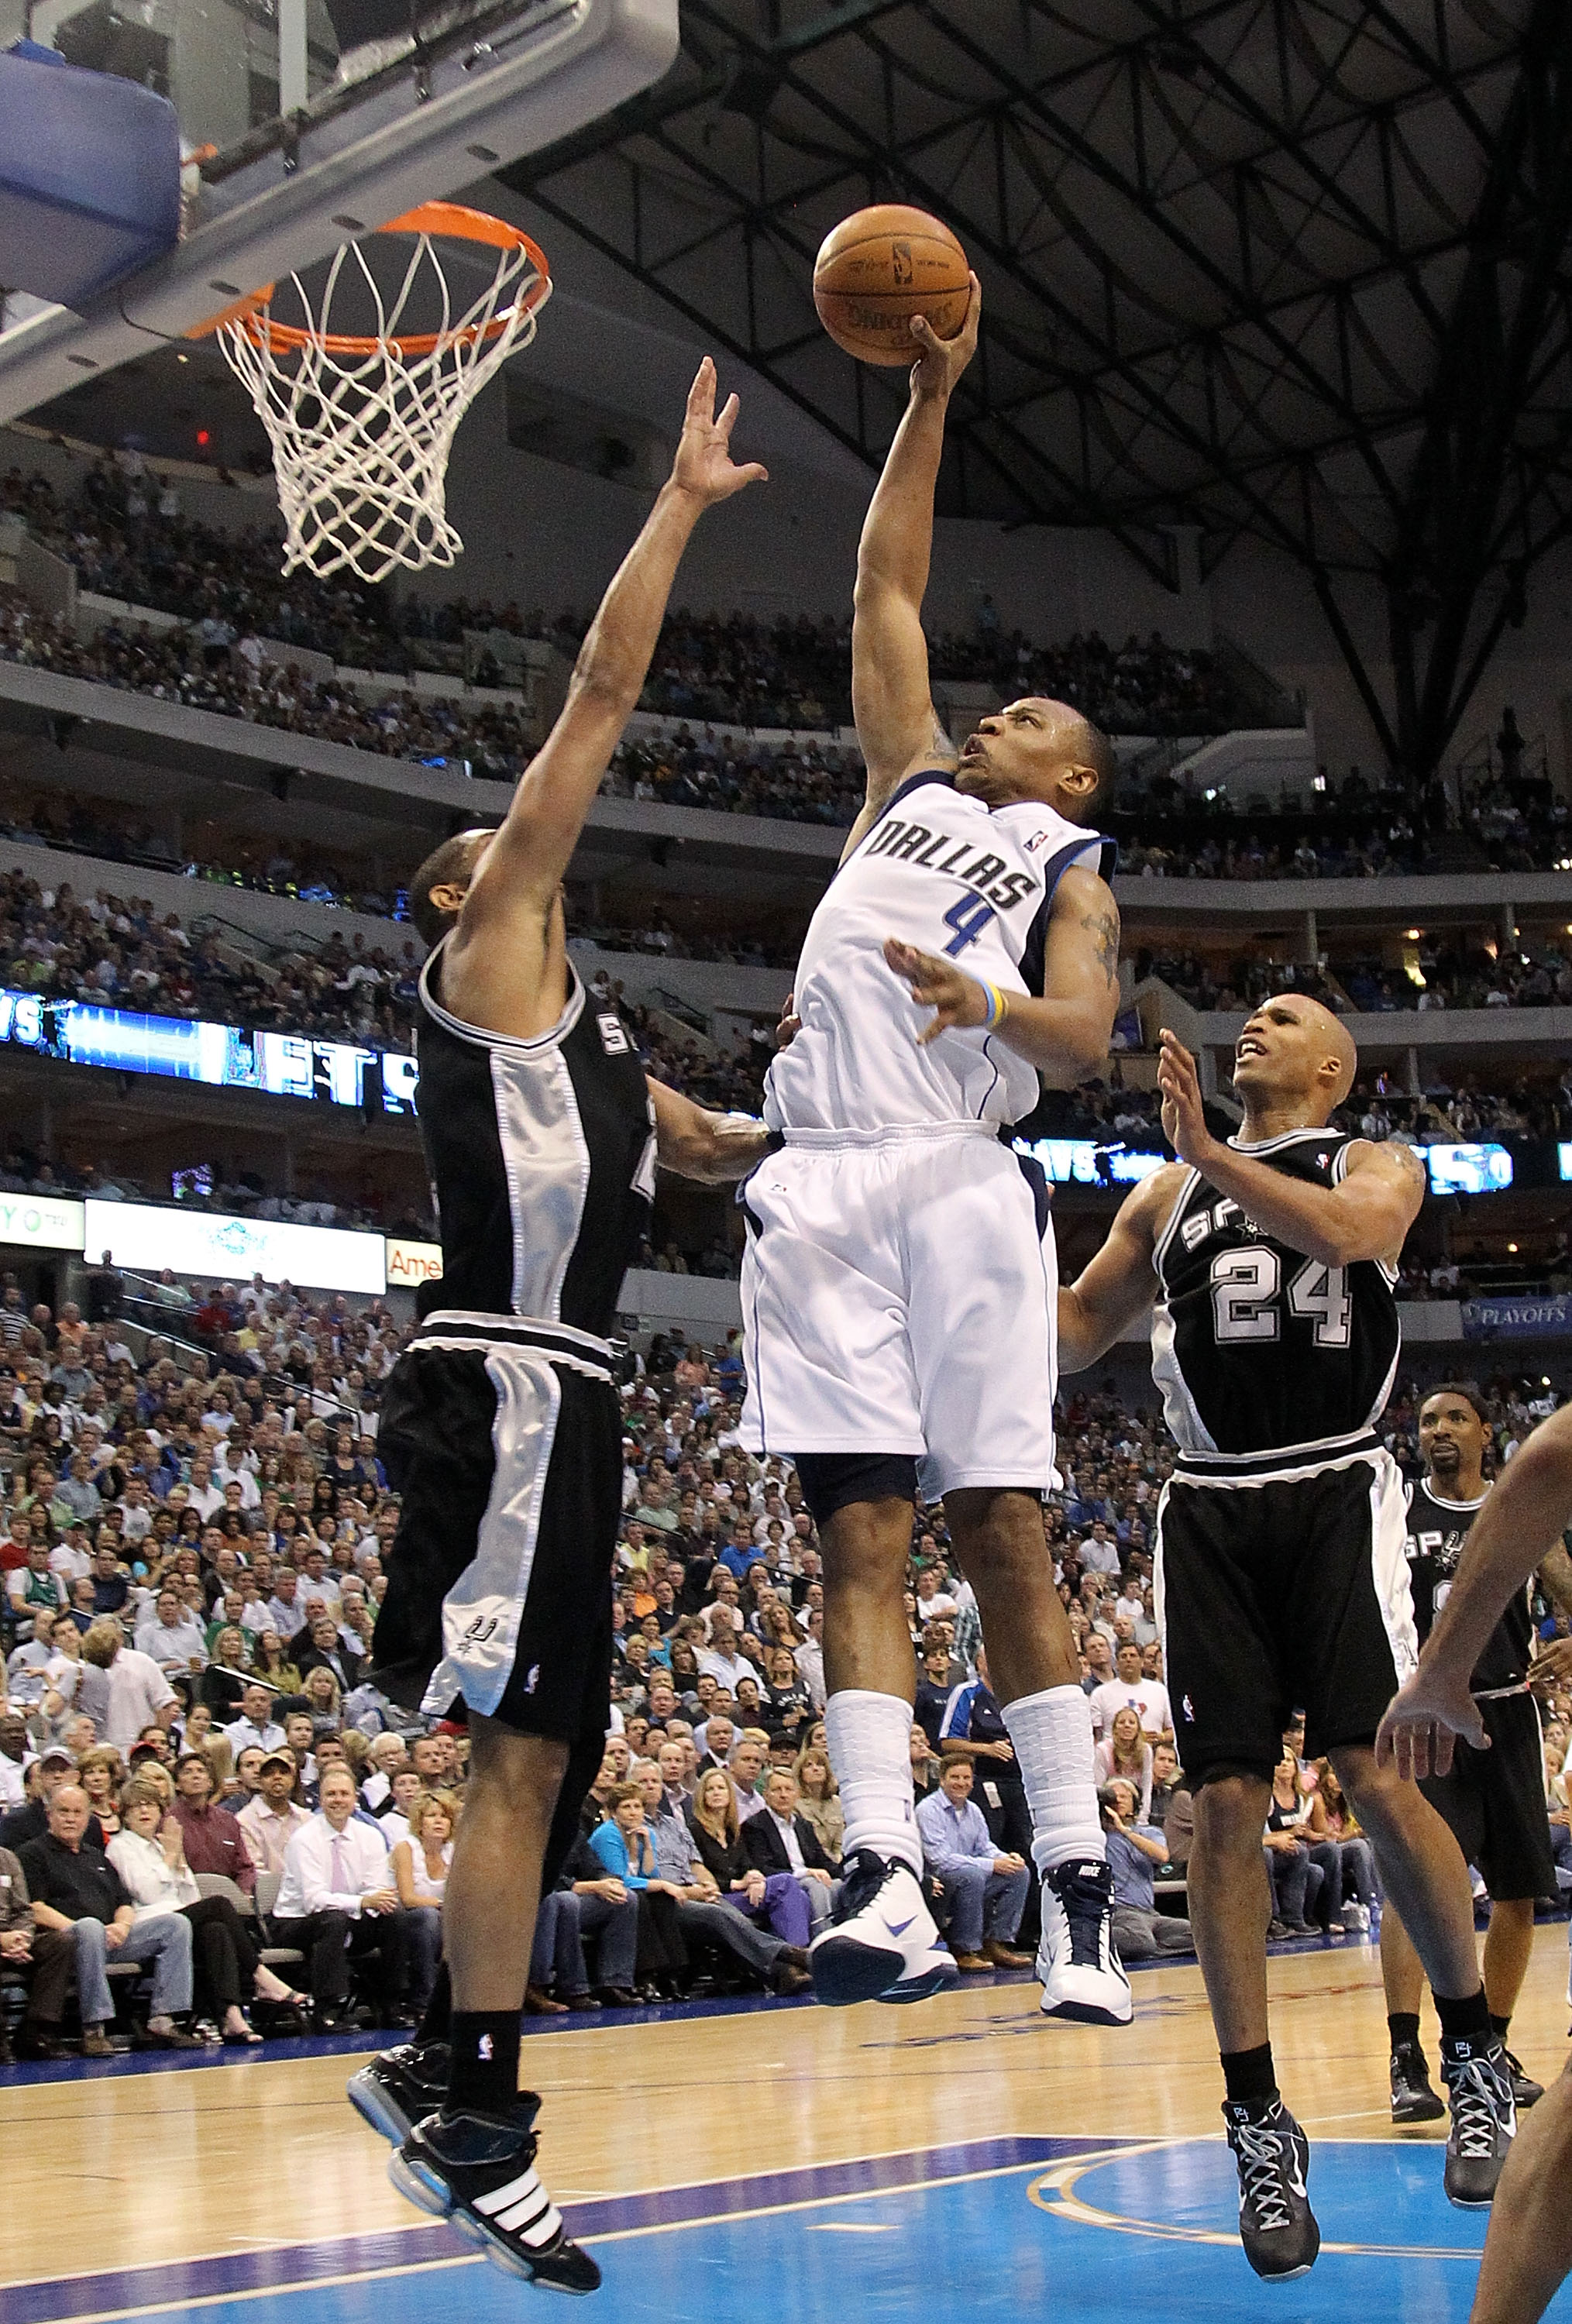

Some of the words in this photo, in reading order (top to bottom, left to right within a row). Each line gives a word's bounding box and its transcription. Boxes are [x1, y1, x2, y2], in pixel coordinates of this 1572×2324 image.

[863, 820, 1039, 909] DALLAS
[941, 889, 998, 959] 4
[1210, 1244, 1353, 1349] 24
[1482, 1307, 1566, 1325] PLAYOFFS
[1078, 1865, 1101, 1877] NIKE
